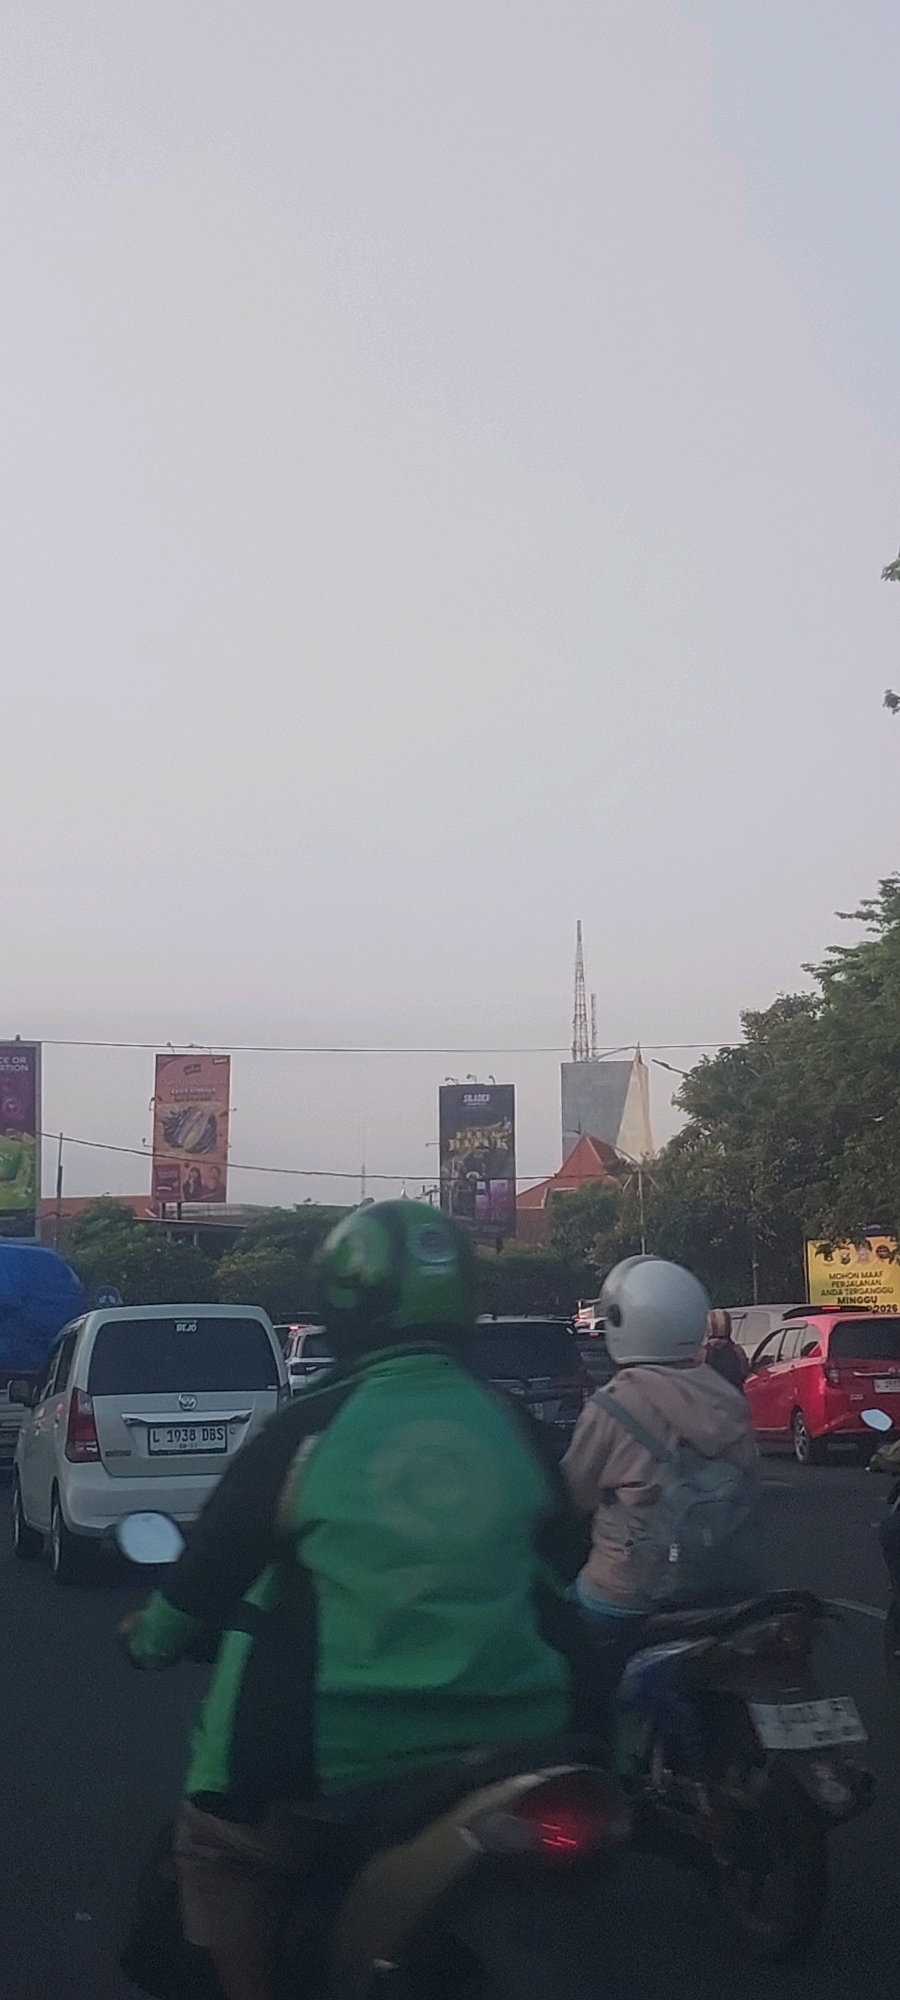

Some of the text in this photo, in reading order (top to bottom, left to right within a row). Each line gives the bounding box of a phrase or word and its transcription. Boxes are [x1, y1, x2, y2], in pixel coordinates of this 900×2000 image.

[12, 1056, 27, 1064] OR
[829, 1270, 883, 1280] MOHON MAAF
[831, 1279, 882, 1288] PERJALANAN
[845, 1287, 894, 1296] TERGANGGU
[837, 1295, 878, 1304] MINGGU
[152, 1427, 224, 1443] L 1938 DBS
